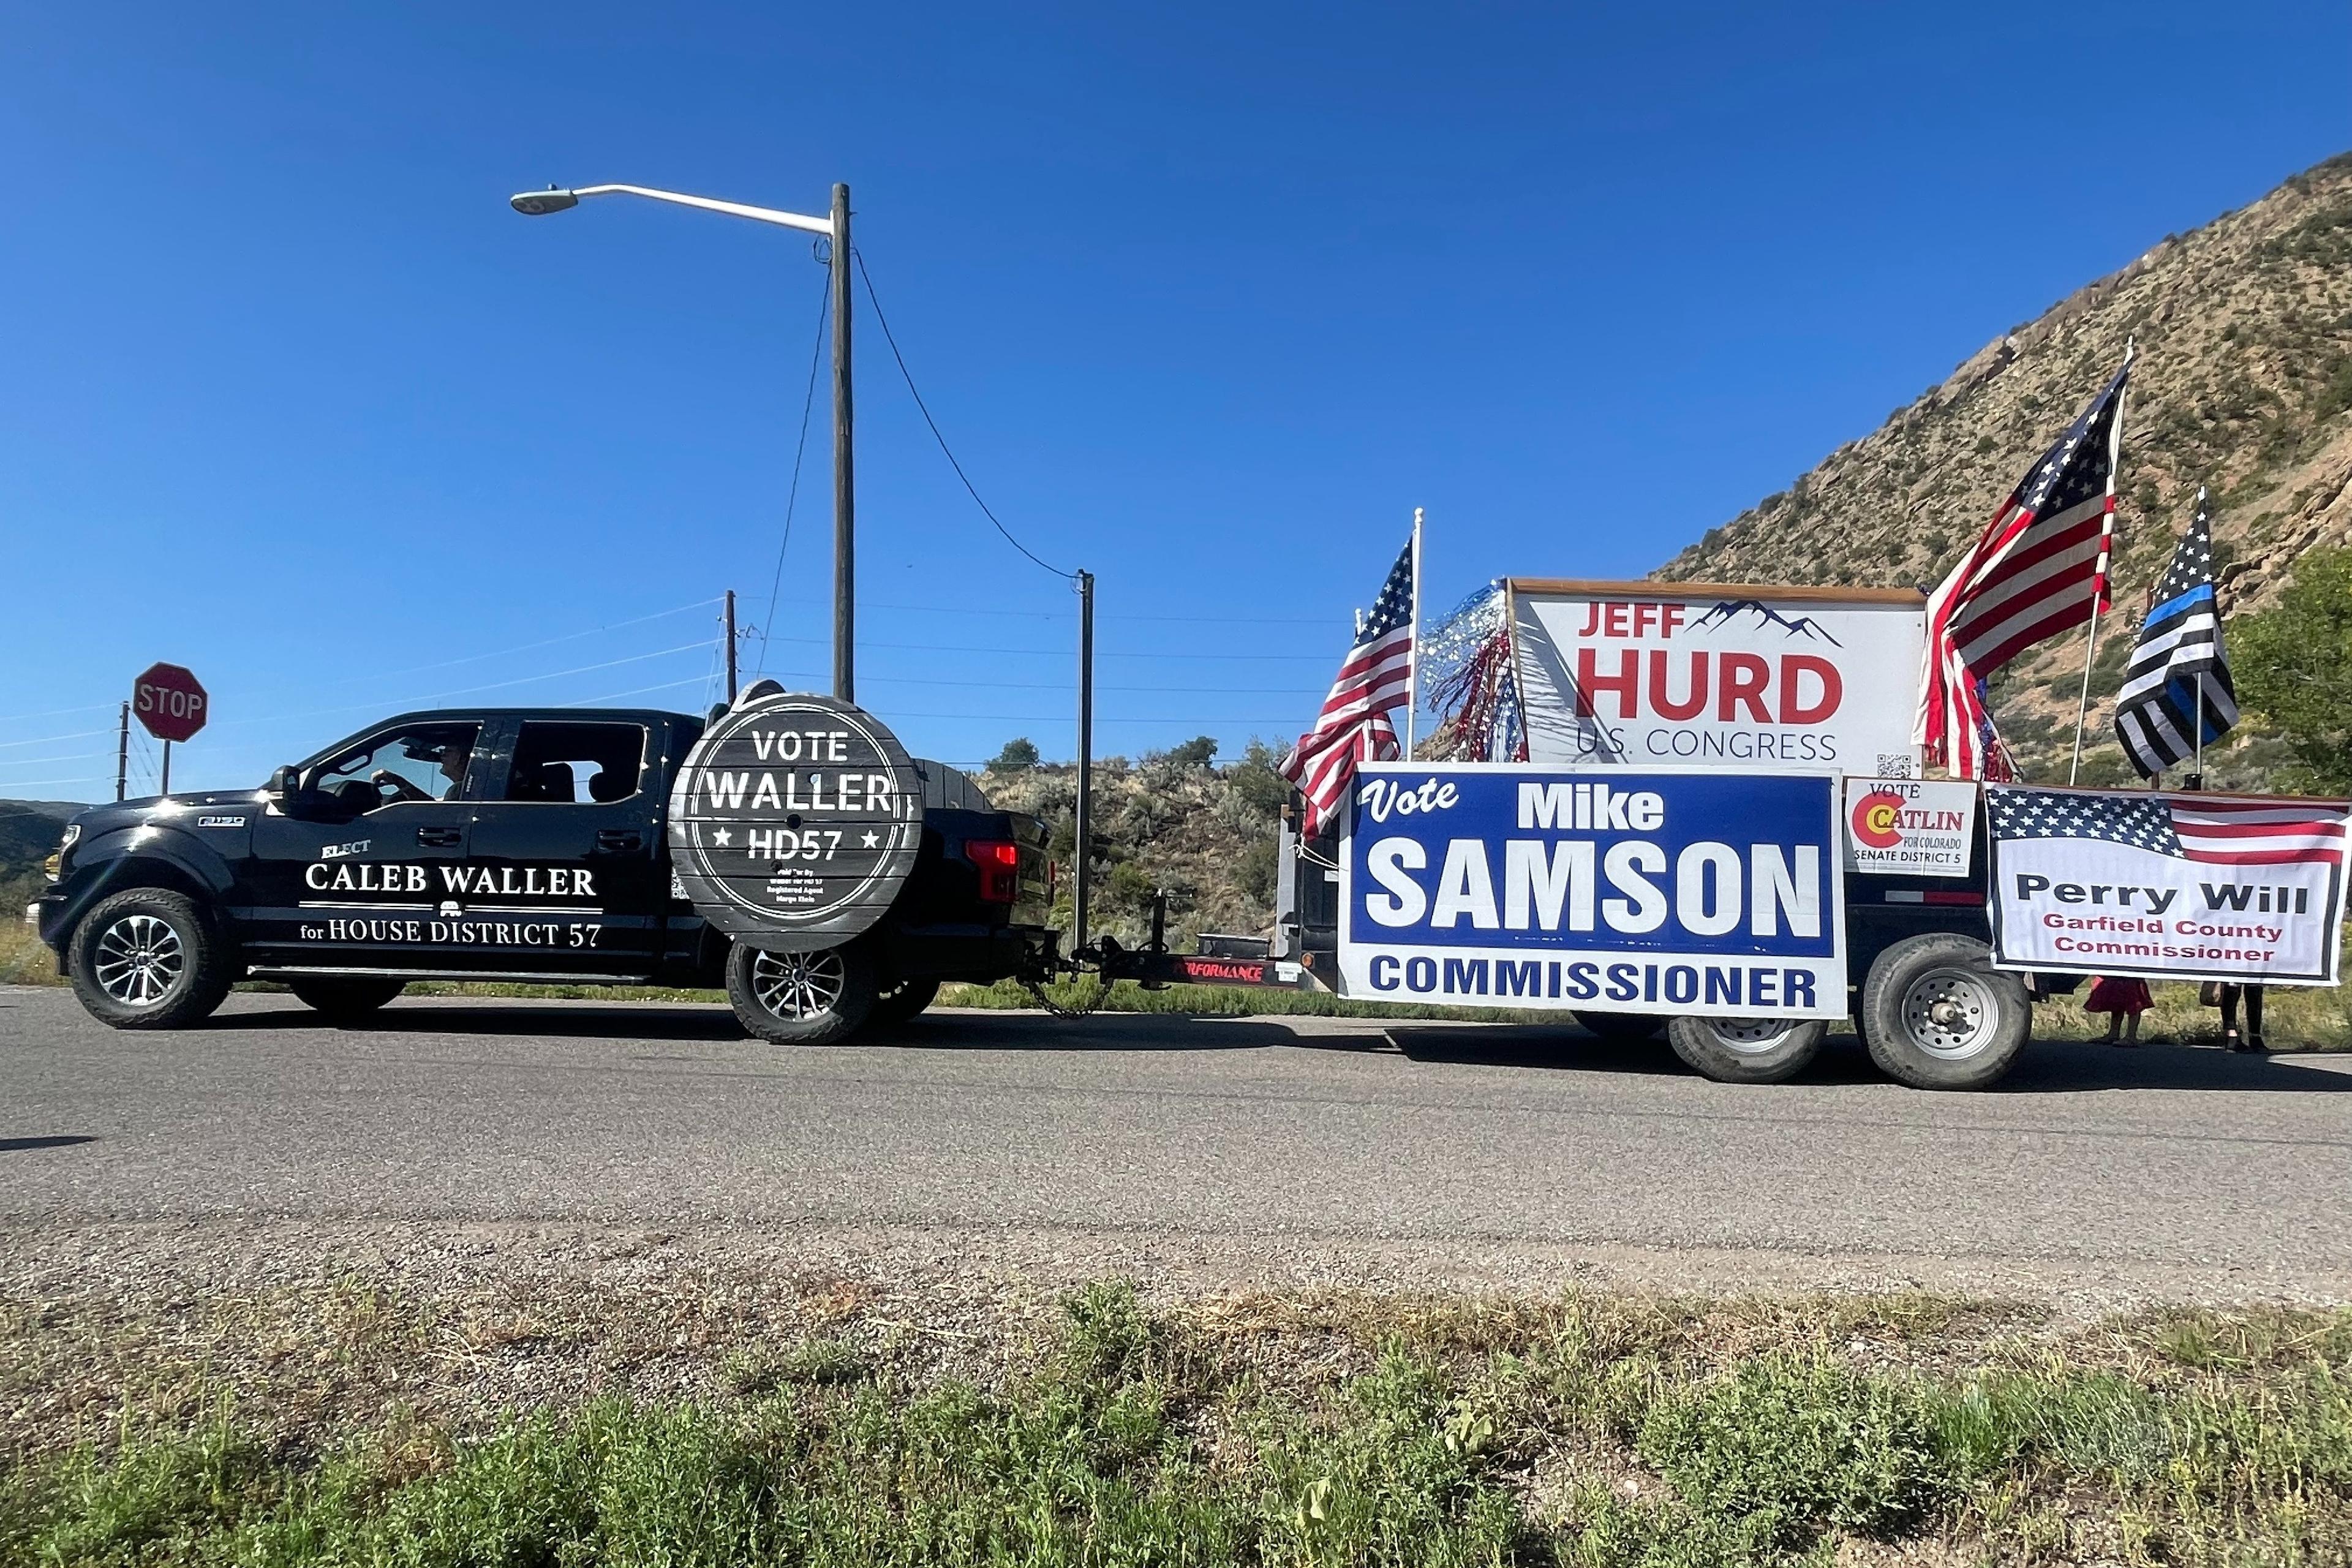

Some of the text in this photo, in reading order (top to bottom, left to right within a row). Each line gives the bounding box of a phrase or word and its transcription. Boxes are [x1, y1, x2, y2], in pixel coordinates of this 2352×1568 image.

[1578, 601, 1686, 638] JEFF
[138, 684, 203, 720] STOP
[1576, 648, 1842, 725] HURD
[752, 730, 848, 761] VOTE
[1577, 728, 1836, 761] U.S. CONGRESS
[706, 772, 892, 812] WALLER
[1357, 777, 1664, 831] Vote Mike
[1870, 783, 1921, 798] VOTE
[1874, 809, 1964, 831] CATLIN
[322, 839, 371, 859] ELECT
[747, 828, 843, 861] HD57
[1855, 850, 1961, 863] SENATE DISTRICT 5
[1904, 837, 1961, 849] FOR COLORADO
[306, 864, 597, 896] CALEB WALLER
[1365, 837, 1820, 937] SAMSON
[2016, 874, 2309, 915] Perry Will
[300, 919, 603, 948] for HOUSE DISTRICT 57
[2043, 914, 2283, 943] Garfield County
[2054, 937, 2275, 961] Commissioner
[1370, 955, 1817, 1008] COMMISSIONER
